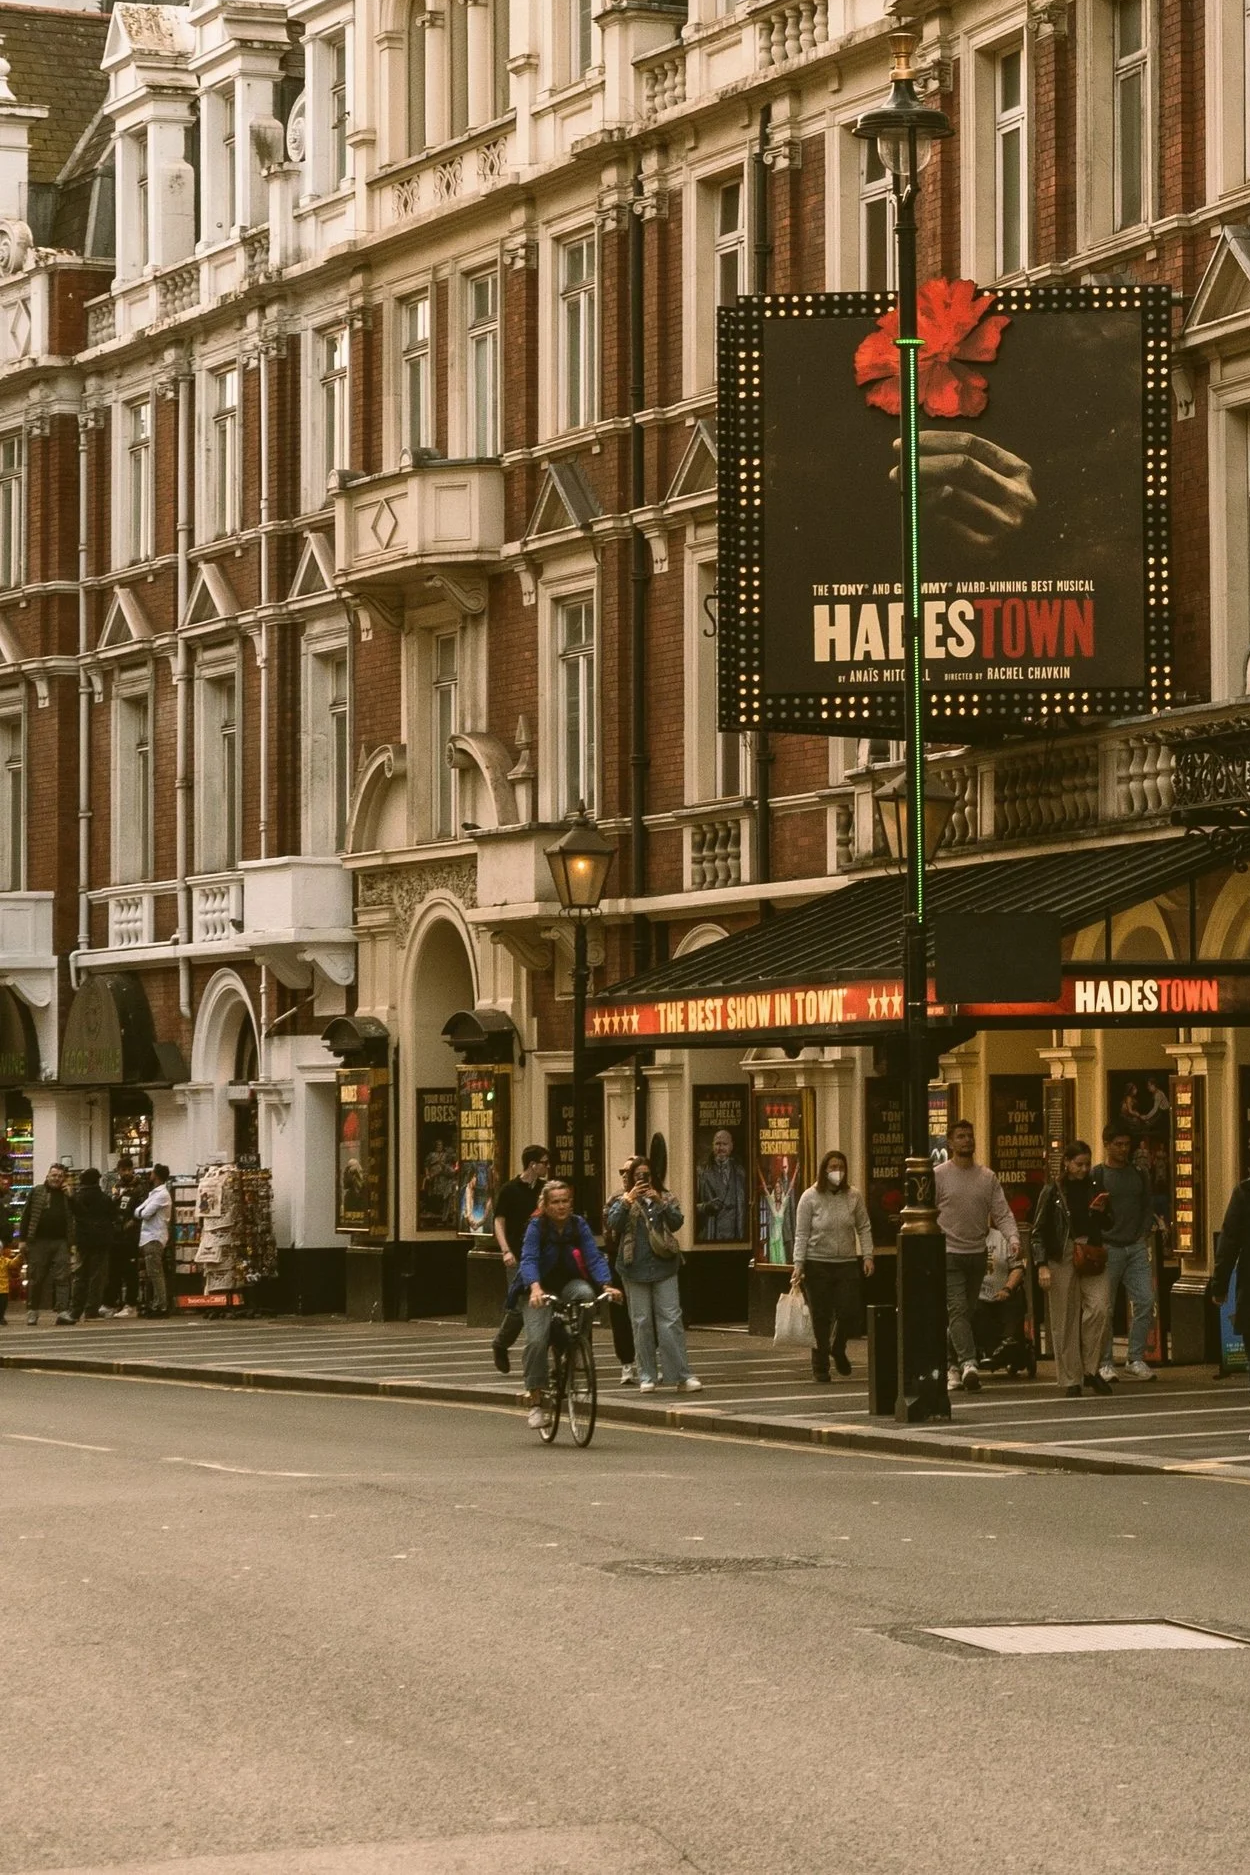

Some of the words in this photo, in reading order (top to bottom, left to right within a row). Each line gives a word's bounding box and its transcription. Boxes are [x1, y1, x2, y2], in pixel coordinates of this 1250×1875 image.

[812, 584, 829, 596] THE
[872, 583, 890, 595] AND
[956, 580, 1028, 593] AWARD-WINNING
[1031, 580, 1053, 592] BEST
[1056, 579, 1095, 592] MUSICAL
[838, 675, 846, 683] BY
[944, 672, 973, 681] DIRECTED
[975, 672, 983, 681] BY
[987, 667, 1024, 680] RACHEL
[1028, 666, 1071, 679] CHAVKIN
[1074, 979, 1219, 1014] HADESTOWN
[687, 999, 724, 1032] BEST
[727, 994, 771, 1030] SHOW
[774, 993, 791, 1028] IN
